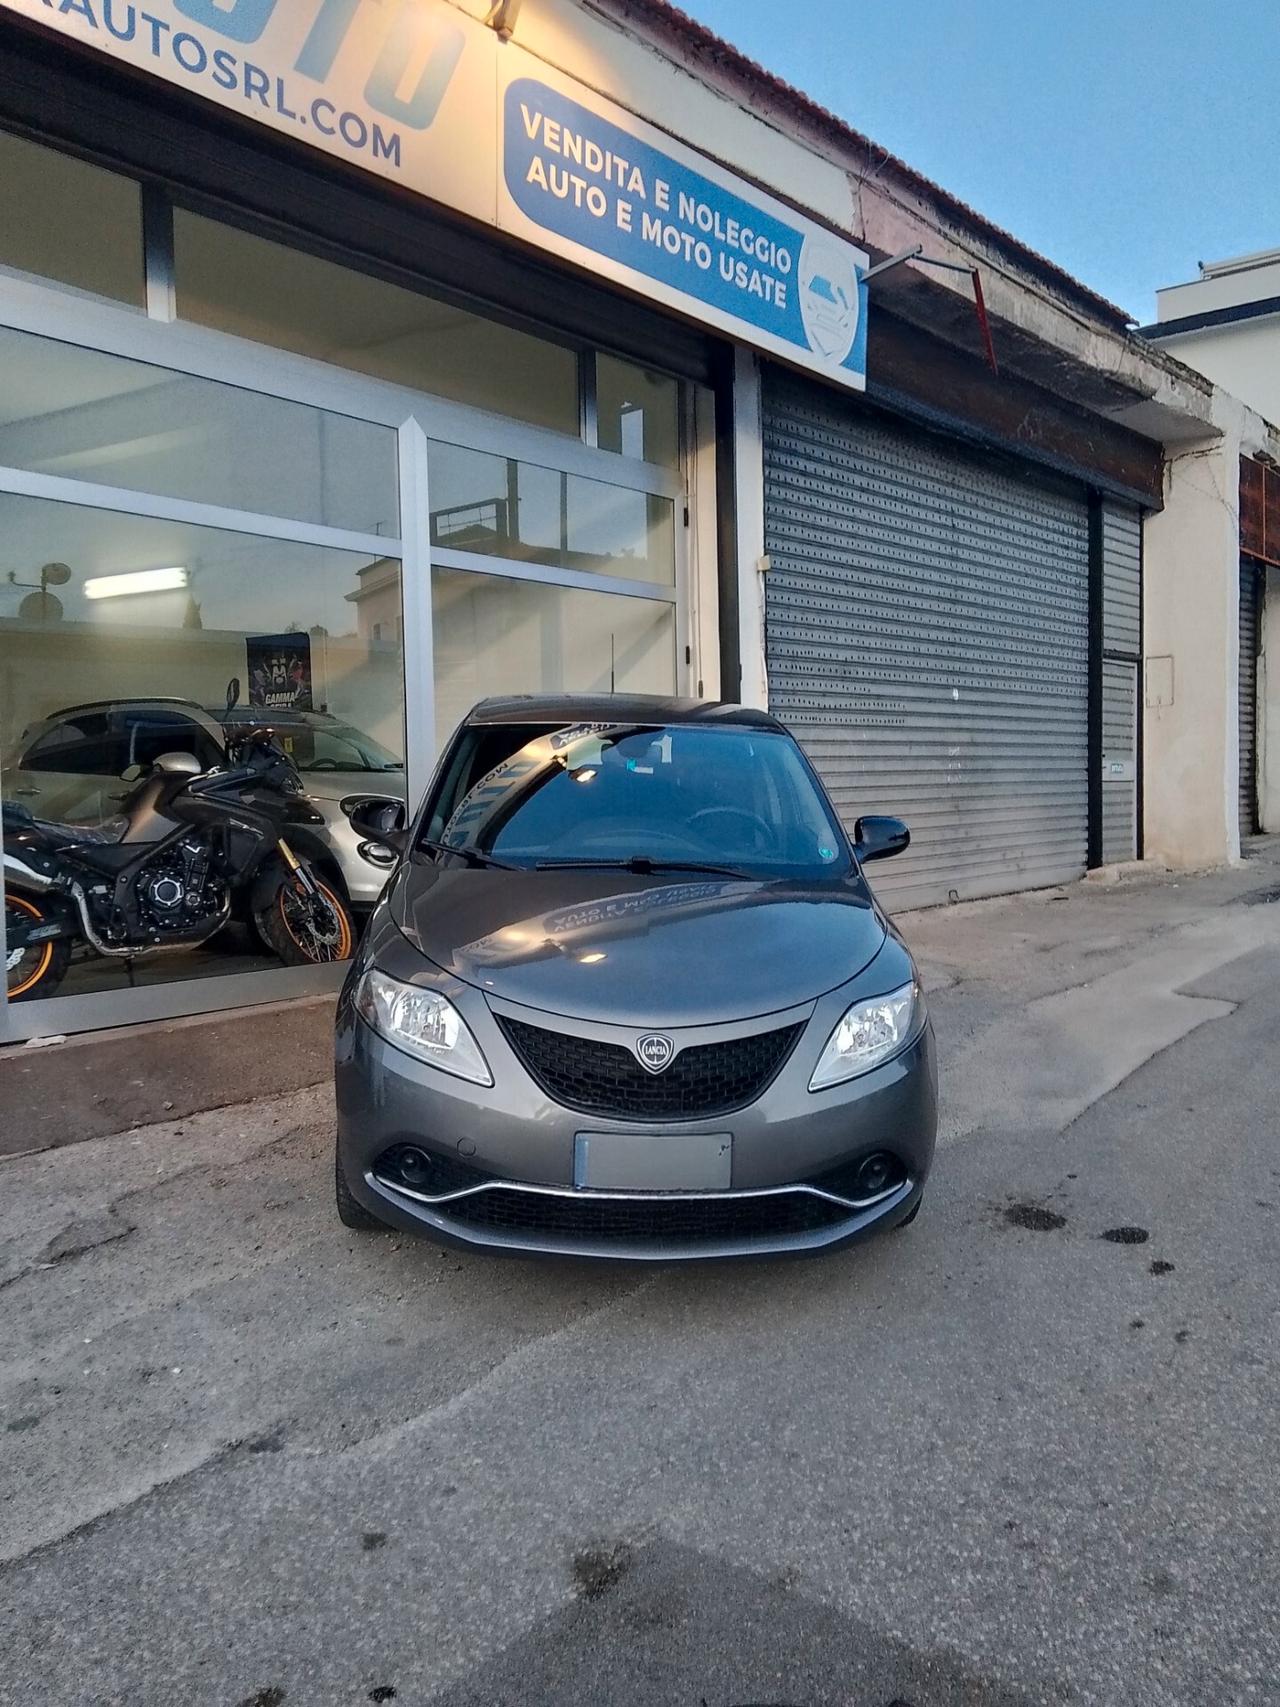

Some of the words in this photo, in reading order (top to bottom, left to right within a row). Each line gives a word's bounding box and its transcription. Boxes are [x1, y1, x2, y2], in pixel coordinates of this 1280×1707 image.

[42, 0, 402, 168] AUTOSRL.COM
[520, 103, 647, 200] VENDITA
[655, 178, 670, 212] E
[678, 191, 793, 275] NOLEGGIO
[526, 155, 607, 218] AUTO
[616, 198, 633, 233] E
[641, 212, 712, 271] MOTO
[719, 252, 787, 309] USATE
[265, 691, 296, 705] GAMMA
[645, 1045, 667, 1055] LANCIA
